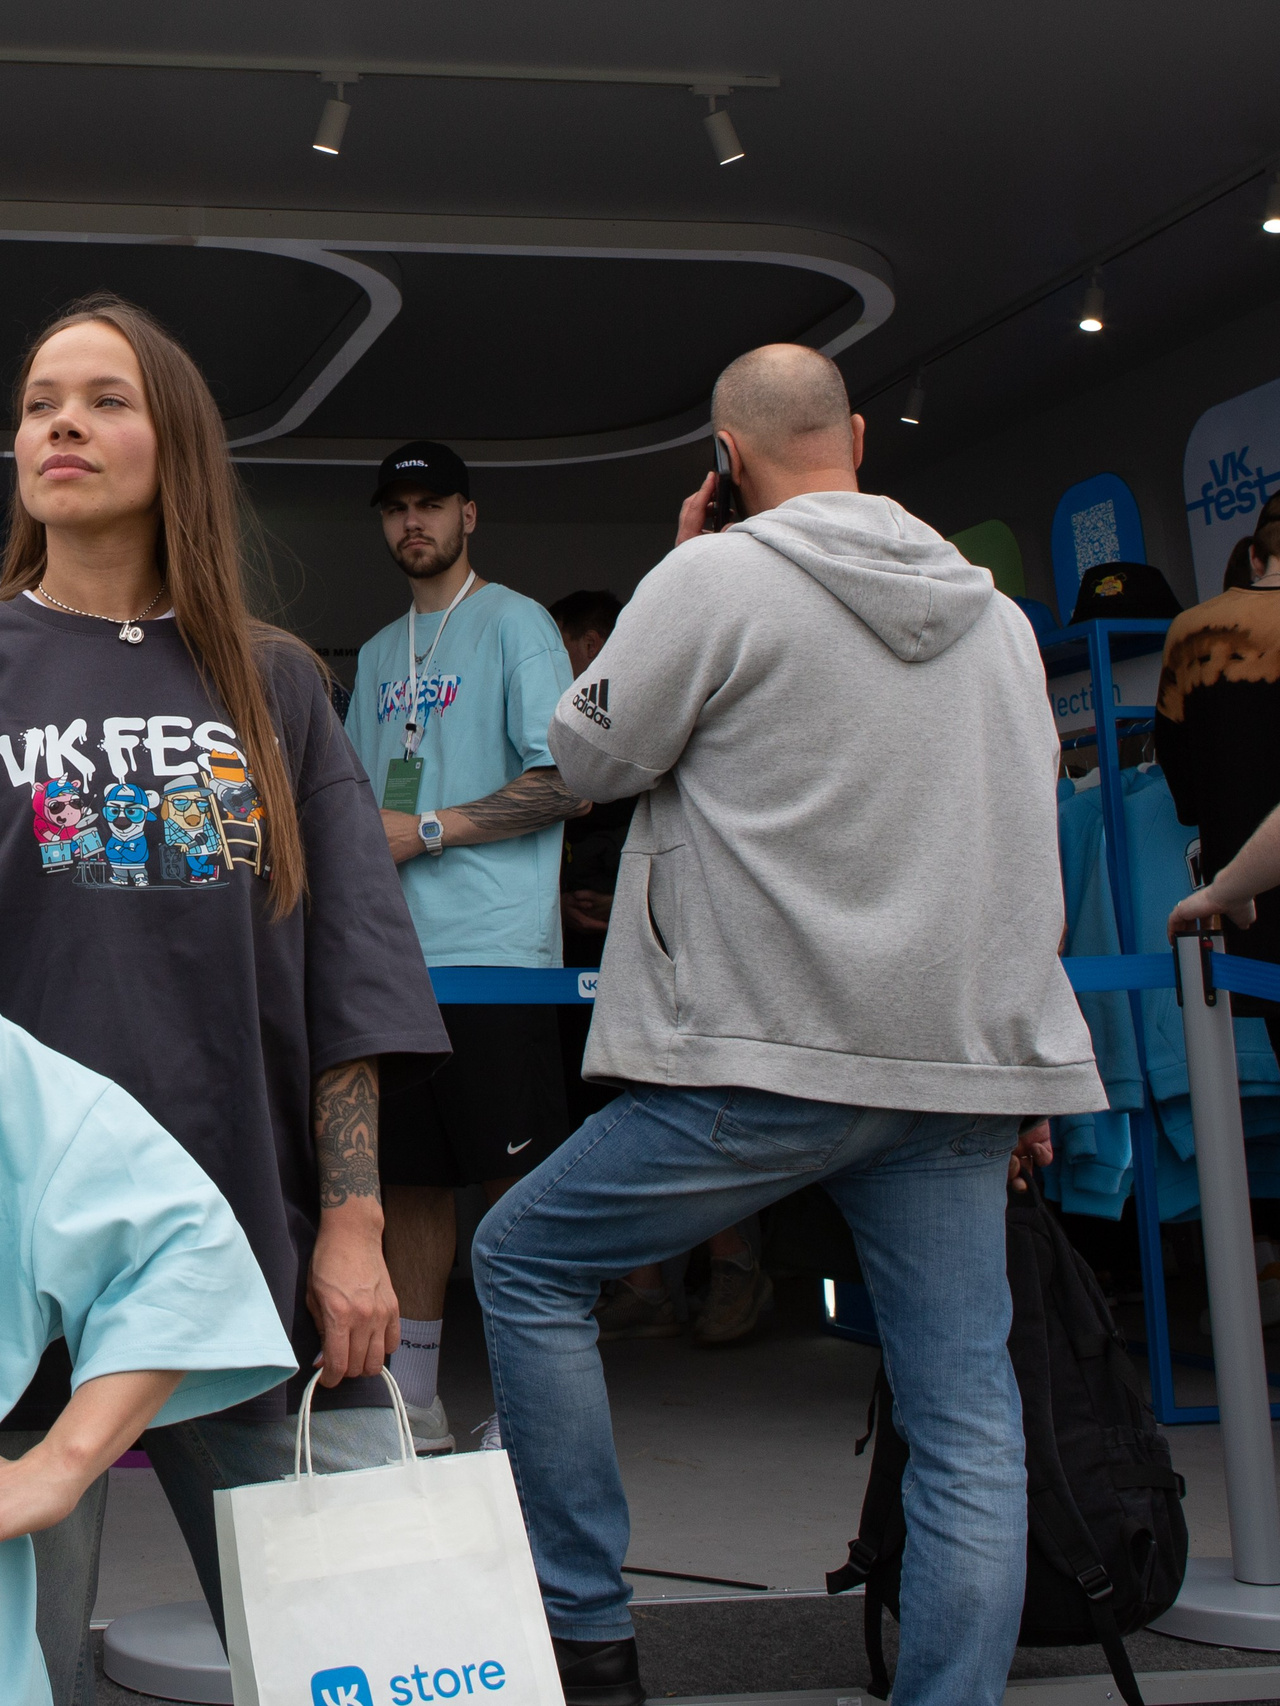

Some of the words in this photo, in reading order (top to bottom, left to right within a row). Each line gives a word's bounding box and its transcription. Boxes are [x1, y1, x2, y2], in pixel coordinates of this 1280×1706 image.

[1209, 446, 1253, 487] VK
[1198, 467, 1277, 526] fest
[378, 681, 403, 714] VK
[573, 694, 611, 729] adidas
[97, 715, 265, 785] FES
[401, 1339, 439, 1349] Reeb
[389, 1660, 506, 1706] store
